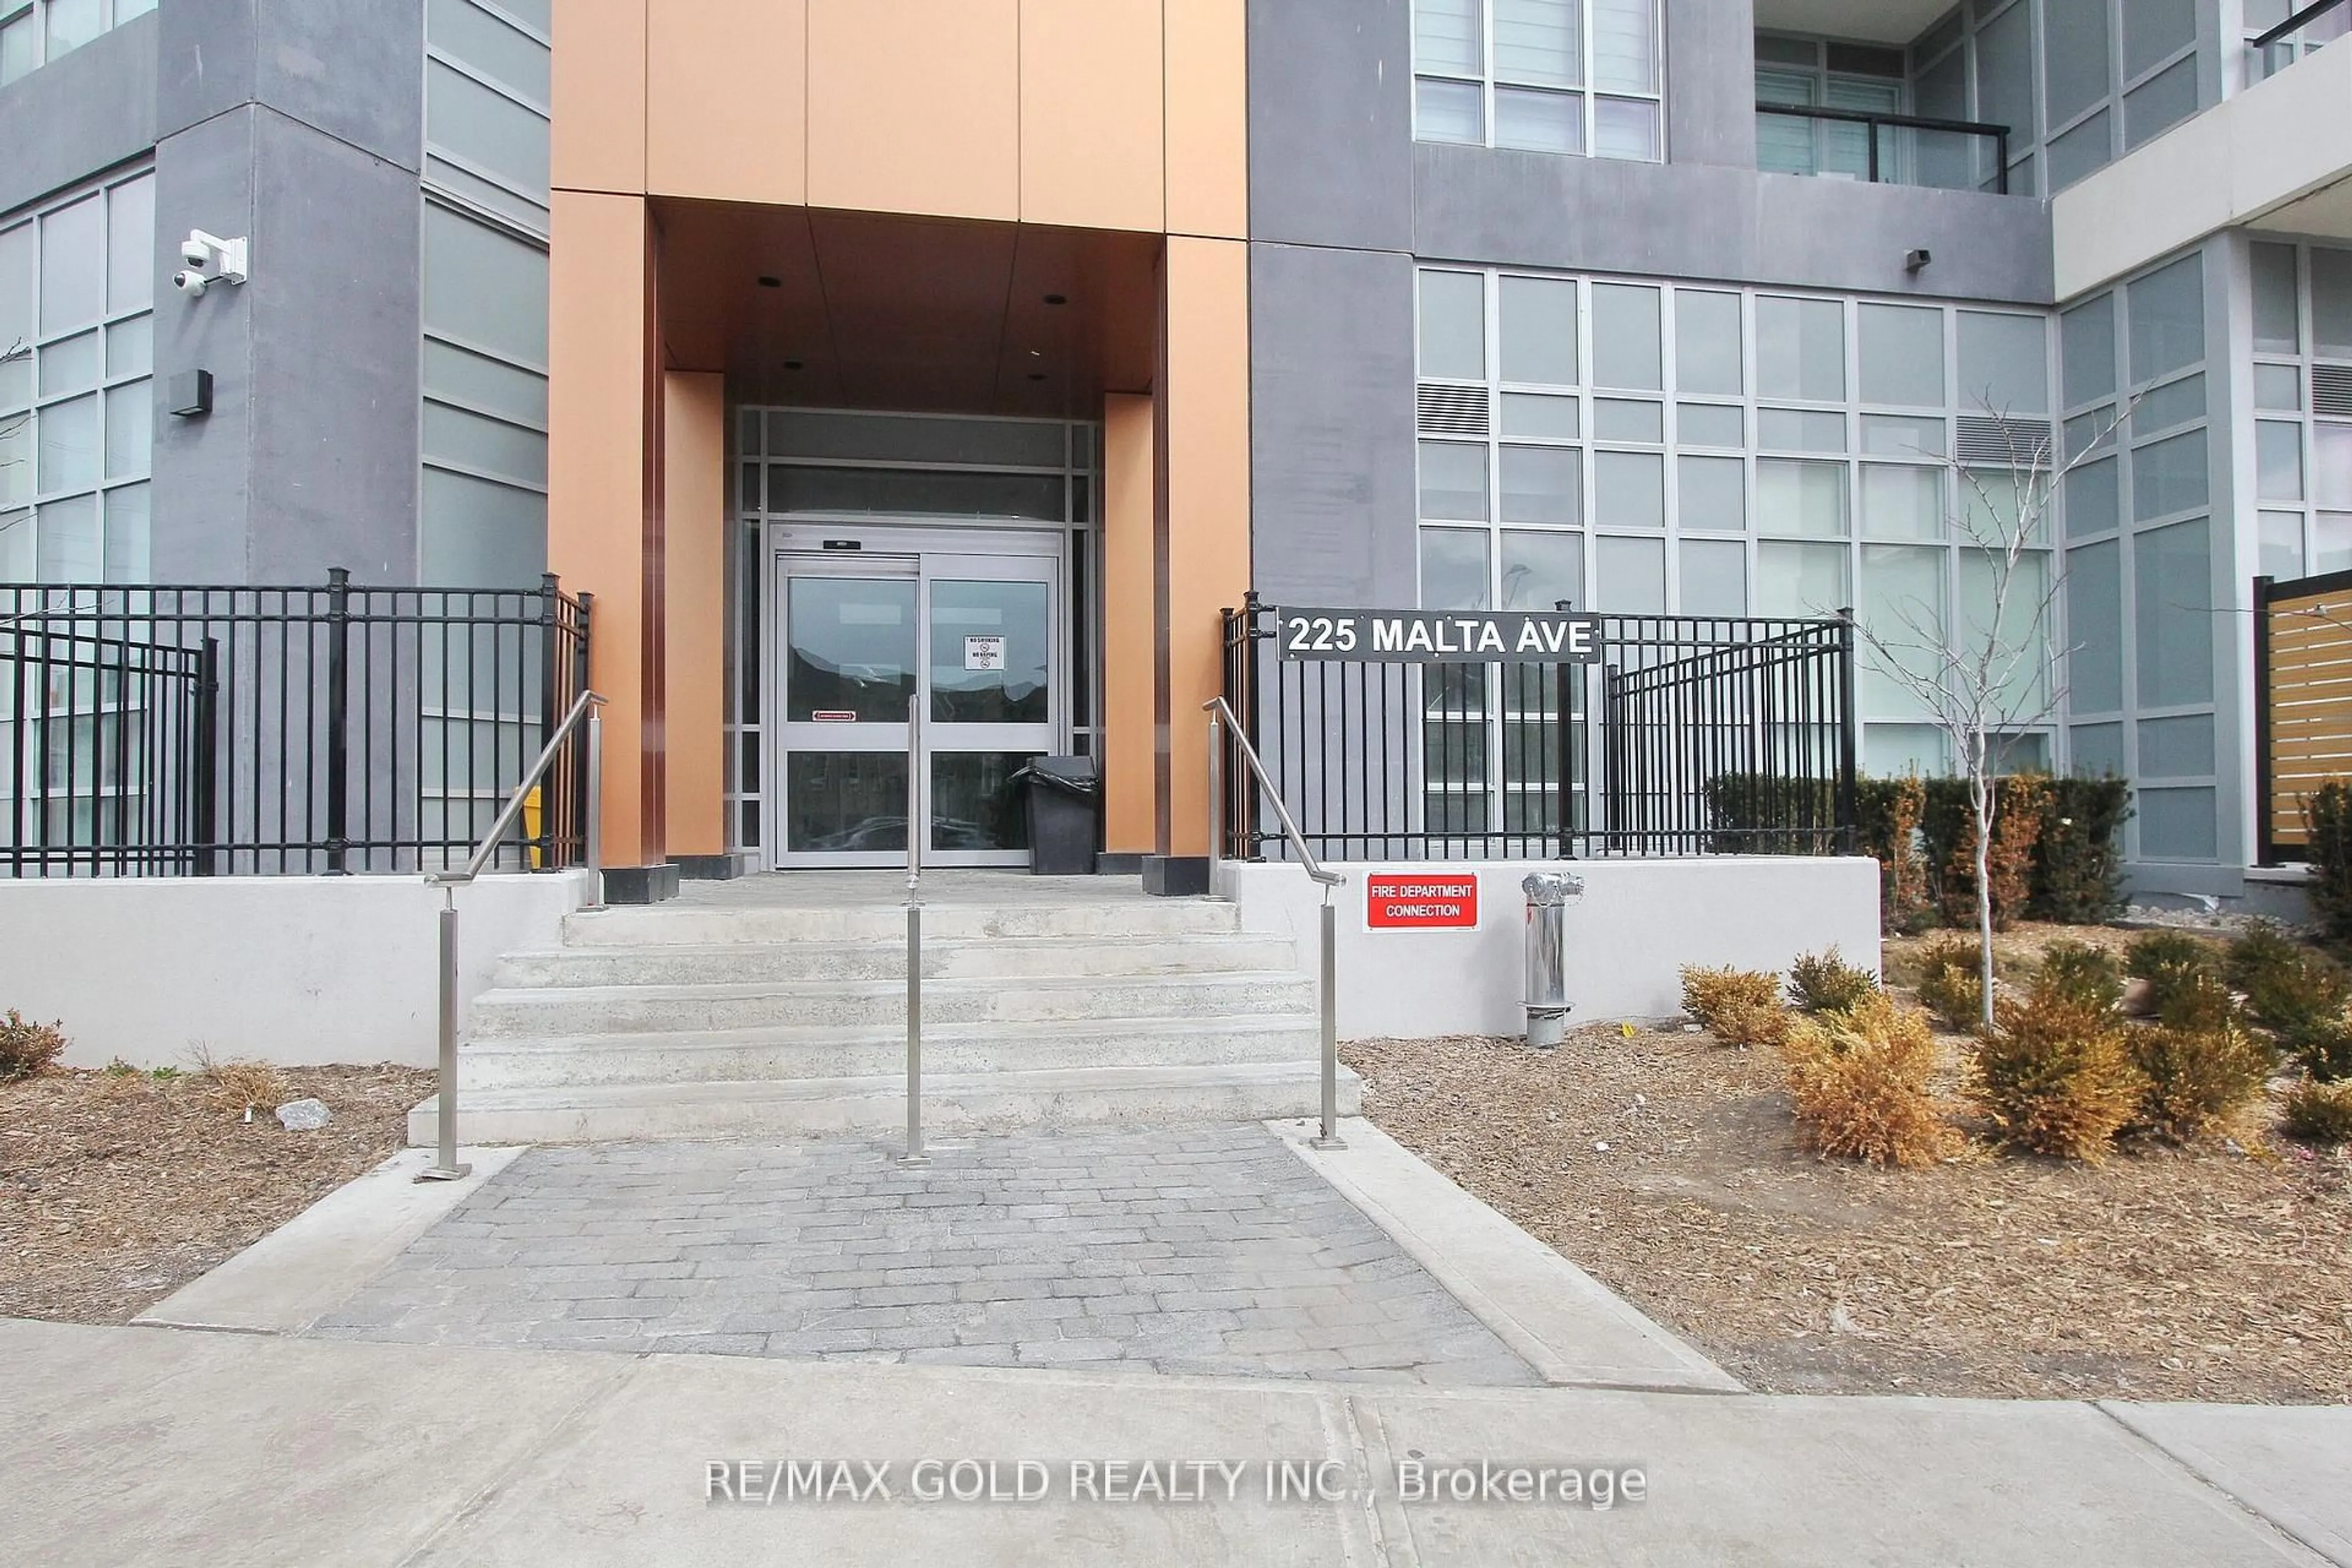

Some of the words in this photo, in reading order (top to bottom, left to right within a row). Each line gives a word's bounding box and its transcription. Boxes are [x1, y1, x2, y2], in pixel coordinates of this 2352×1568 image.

[1288, 617, 1357, 651] 225
[1372, 619, 1506, 652] MALTA
[1515, 619, 1593, 652] AVE
[1371, 886, 1396, 897] FIRE
[1400, 885, 1472, 897] DEPARTMENT
[1386, 905, 1460, 916] CONNECTION
